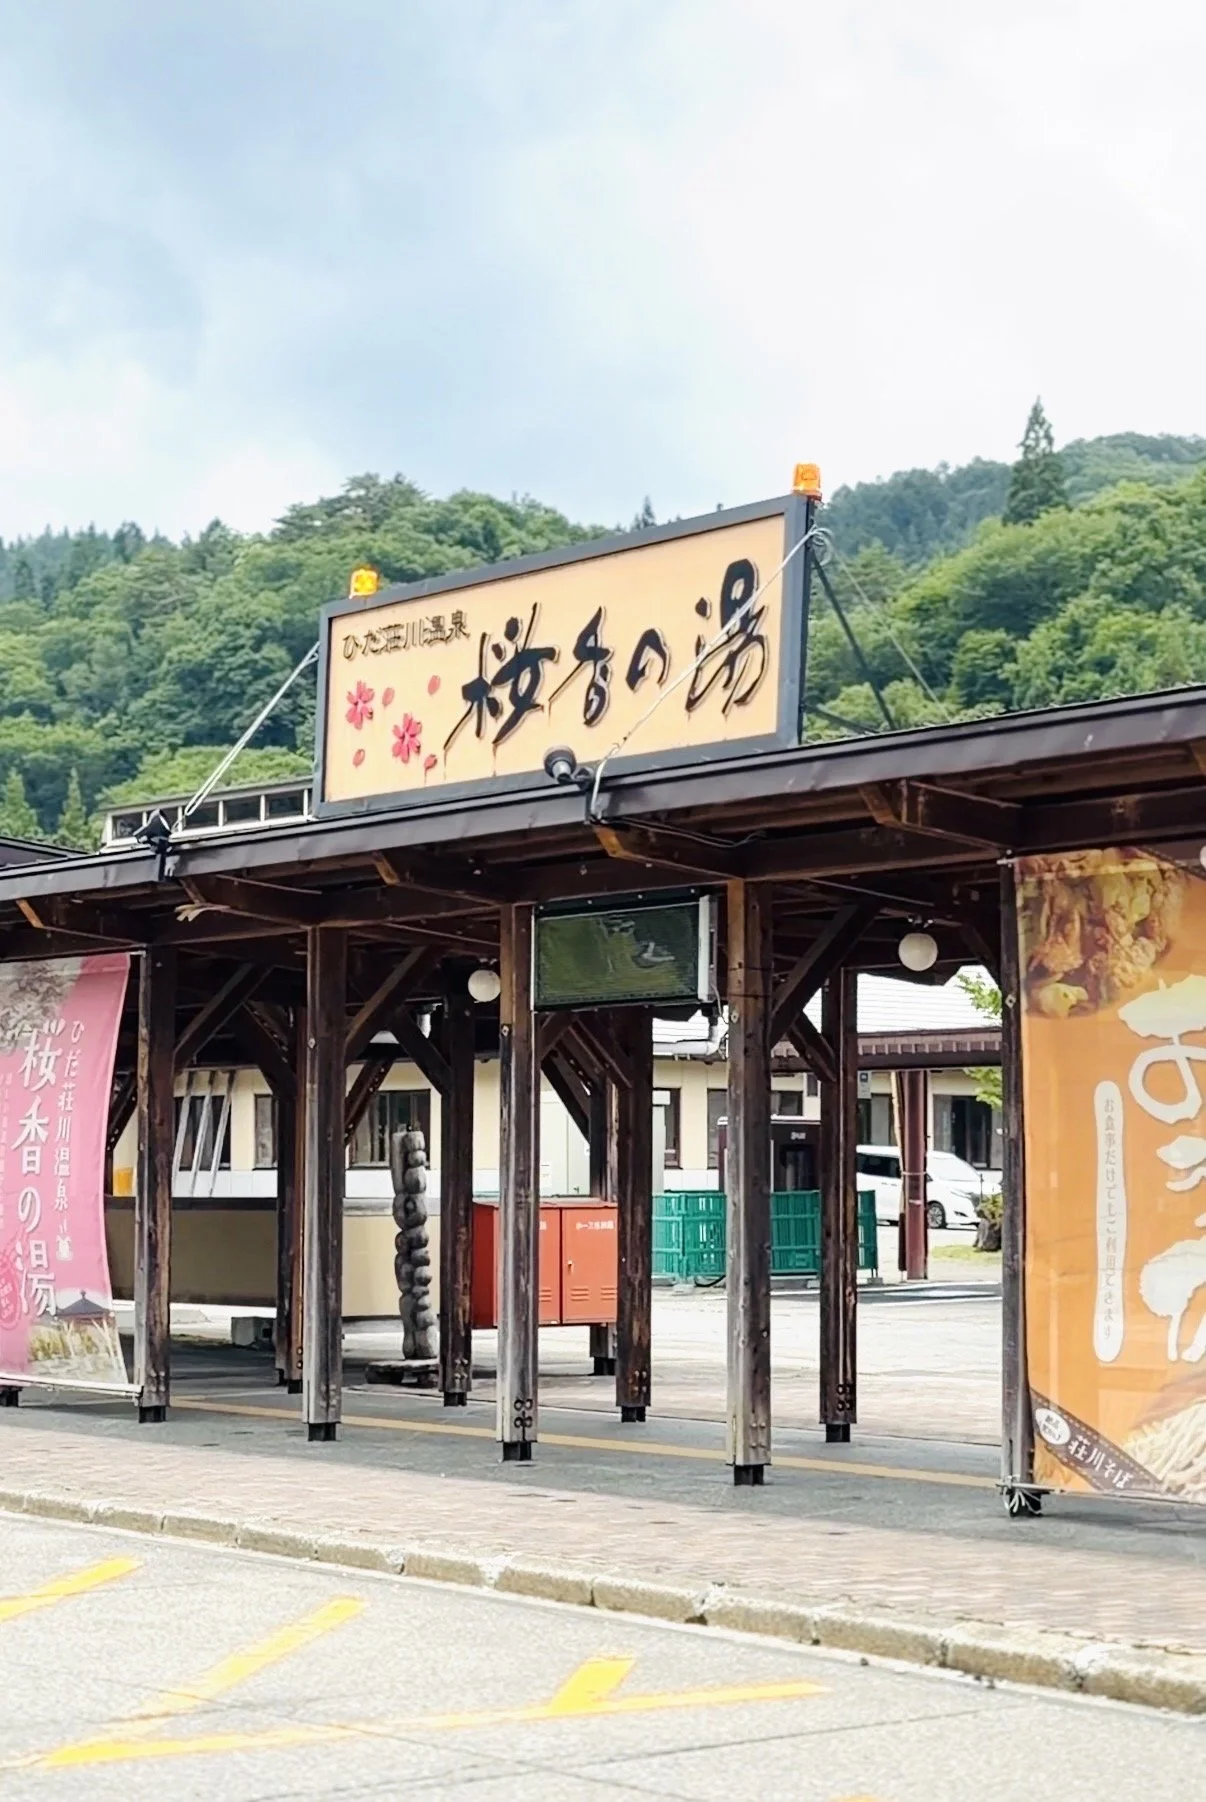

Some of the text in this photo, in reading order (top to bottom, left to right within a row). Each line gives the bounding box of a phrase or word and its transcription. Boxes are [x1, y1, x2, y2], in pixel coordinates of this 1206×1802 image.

[342, 610, 470, 660] ひだ荘川温泉
[444, 558, 768, 751] 桜香の湯
[11, 1018, 63, 1316] 桜香の湯
[54, 1020, 84, 1212] ひだ荘川温泉
[1068, 1434, 1134, 1489] 荘川そば
